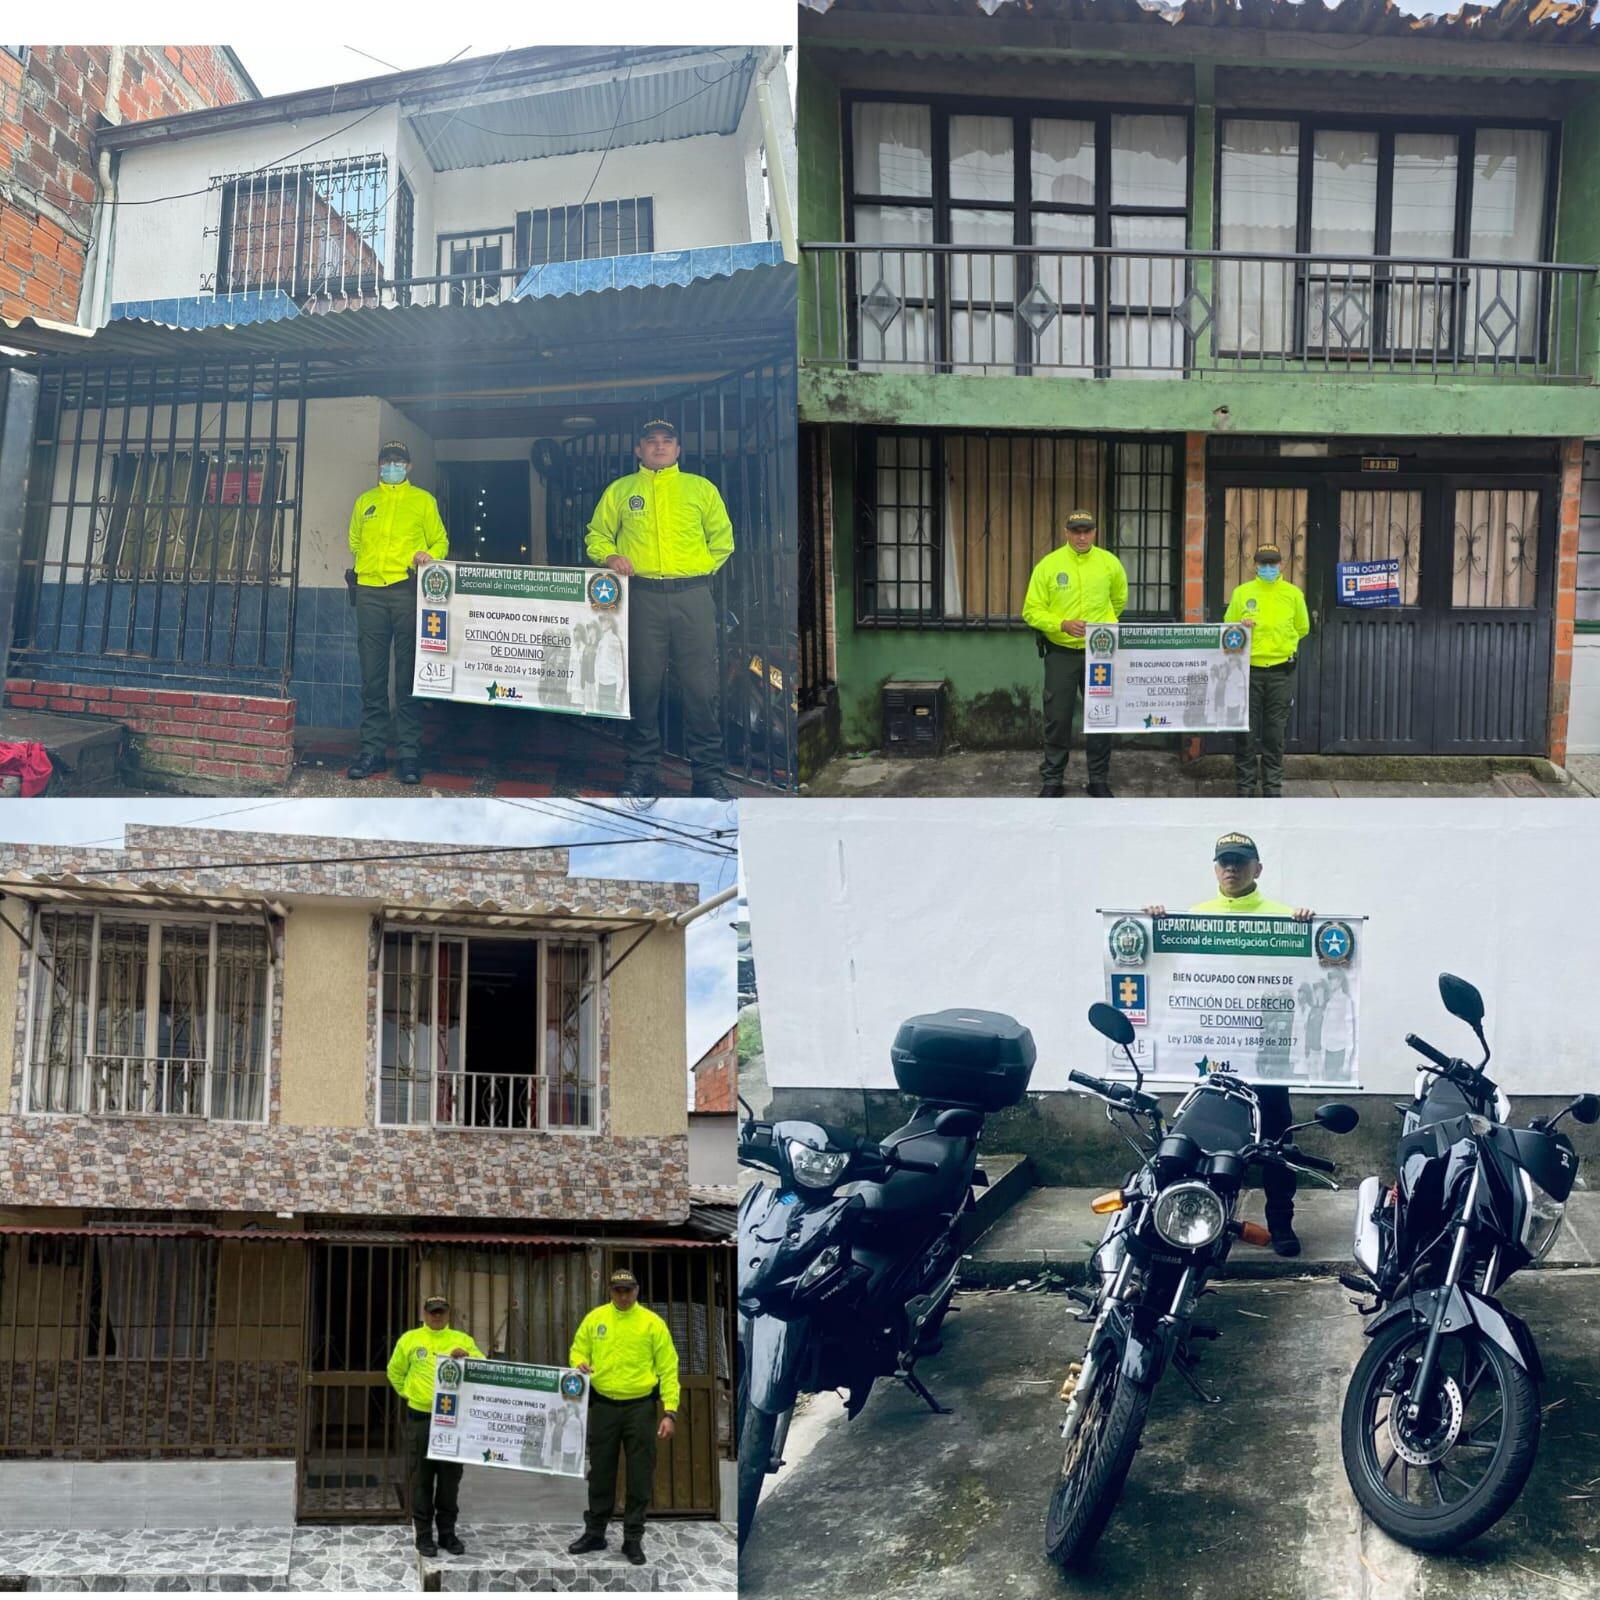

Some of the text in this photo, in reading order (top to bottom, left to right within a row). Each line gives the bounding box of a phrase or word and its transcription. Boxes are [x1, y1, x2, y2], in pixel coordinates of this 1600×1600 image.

[460, 567, 511, 579] DEPARTAMENTO
[513, 569, 521, 580] DE
[524, 570, 550, 581] POLICIA
[1359, 575, 1396, 584] FISCALA
[504, 582, 548, 592] investigación
[550, 585, 578, 594] Criminal
[486, 612, 520, 620] OCUPADO
[540, 616, 558, 624] FINES
[466, 629, 571, 646] EXTINCIÓN DEL DERECHO
[491, 646, 544, 658] DE DOMINIO
[427, 662, 445, 676] SAE
[465, 661, 475, 670] Ley
[477, 663, 492, 671] 1708
[505, 666, 520, 674] 2014
[529, 668, 544, 677] 1849
[557, 670, 574, 678] 2017
[1158, 918, 1223, 932] DEPARTAMENTO
[1226, 920, 1236, 933] DE
[1239, 921, 1271, 934] POLICIA
[1161, 935, 1304, 948] Seccional de investigación Criminal
[1173, 973, 1293, 984] BIEN OCUPADO CON FINES DE
[1169, 995, 1295, 1010] EXTINCIÓN DEL DERECHO
[1200, 1015, 1262, 1026] DE DOMINIO
[1168, 1035, 1297, 1047] Ley 1708 de 2014 y 1849 de 2017
